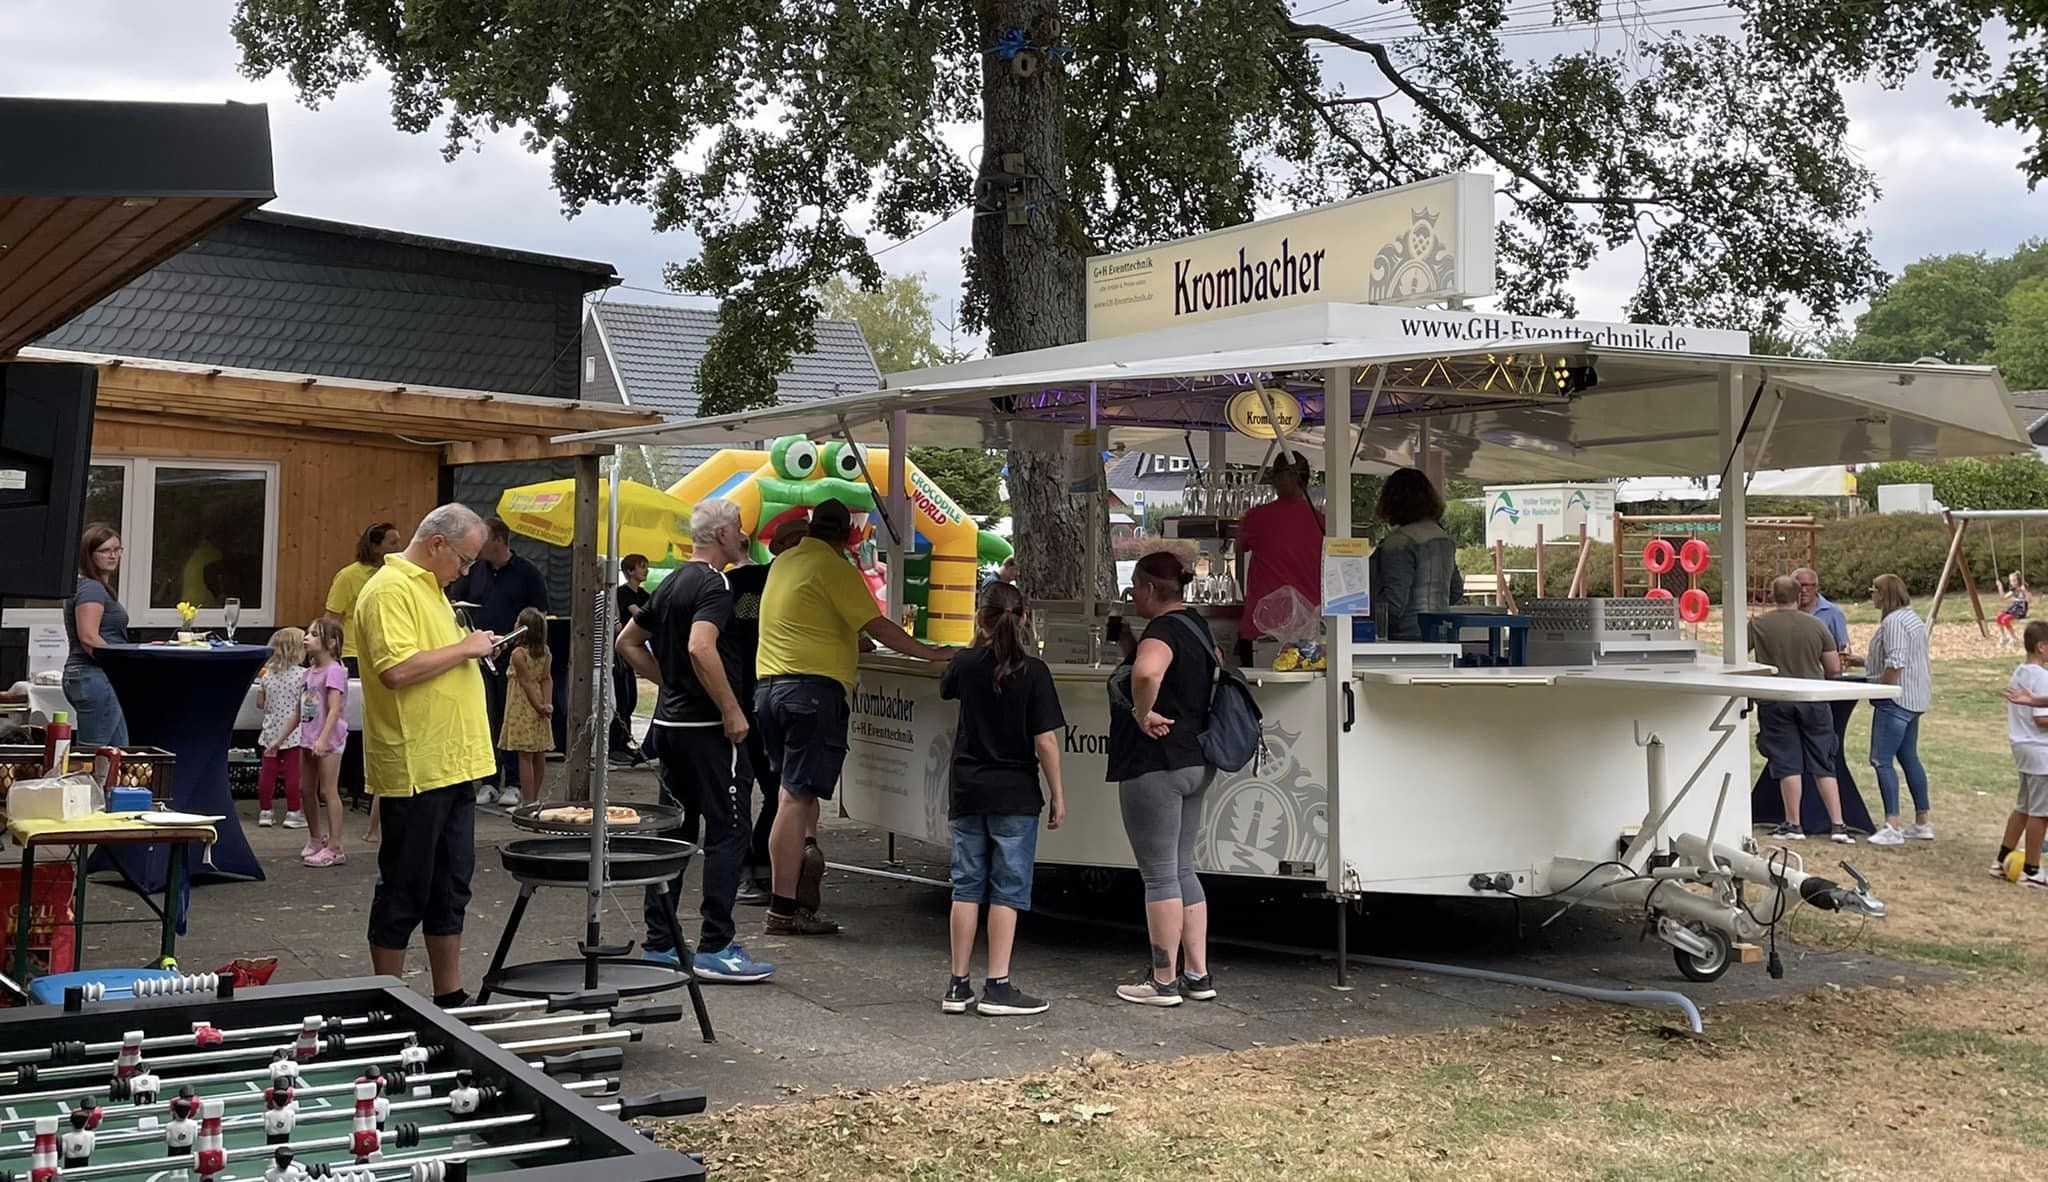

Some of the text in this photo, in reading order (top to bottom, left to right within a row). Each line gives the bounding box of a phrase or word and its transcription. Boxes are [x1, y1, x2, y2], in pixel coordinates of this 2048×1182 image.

[1109, 257, 1153, 275] Eventtechnik
[1174, 237, 1325, 316] Krombacher
[911, 472, 962, 524] CROCODILE
[913, 489, 947, 525] WORLD
[851, 683, 914, 722] Krombacher
[851, 720, 914, 744] G+H Eventtechnik
